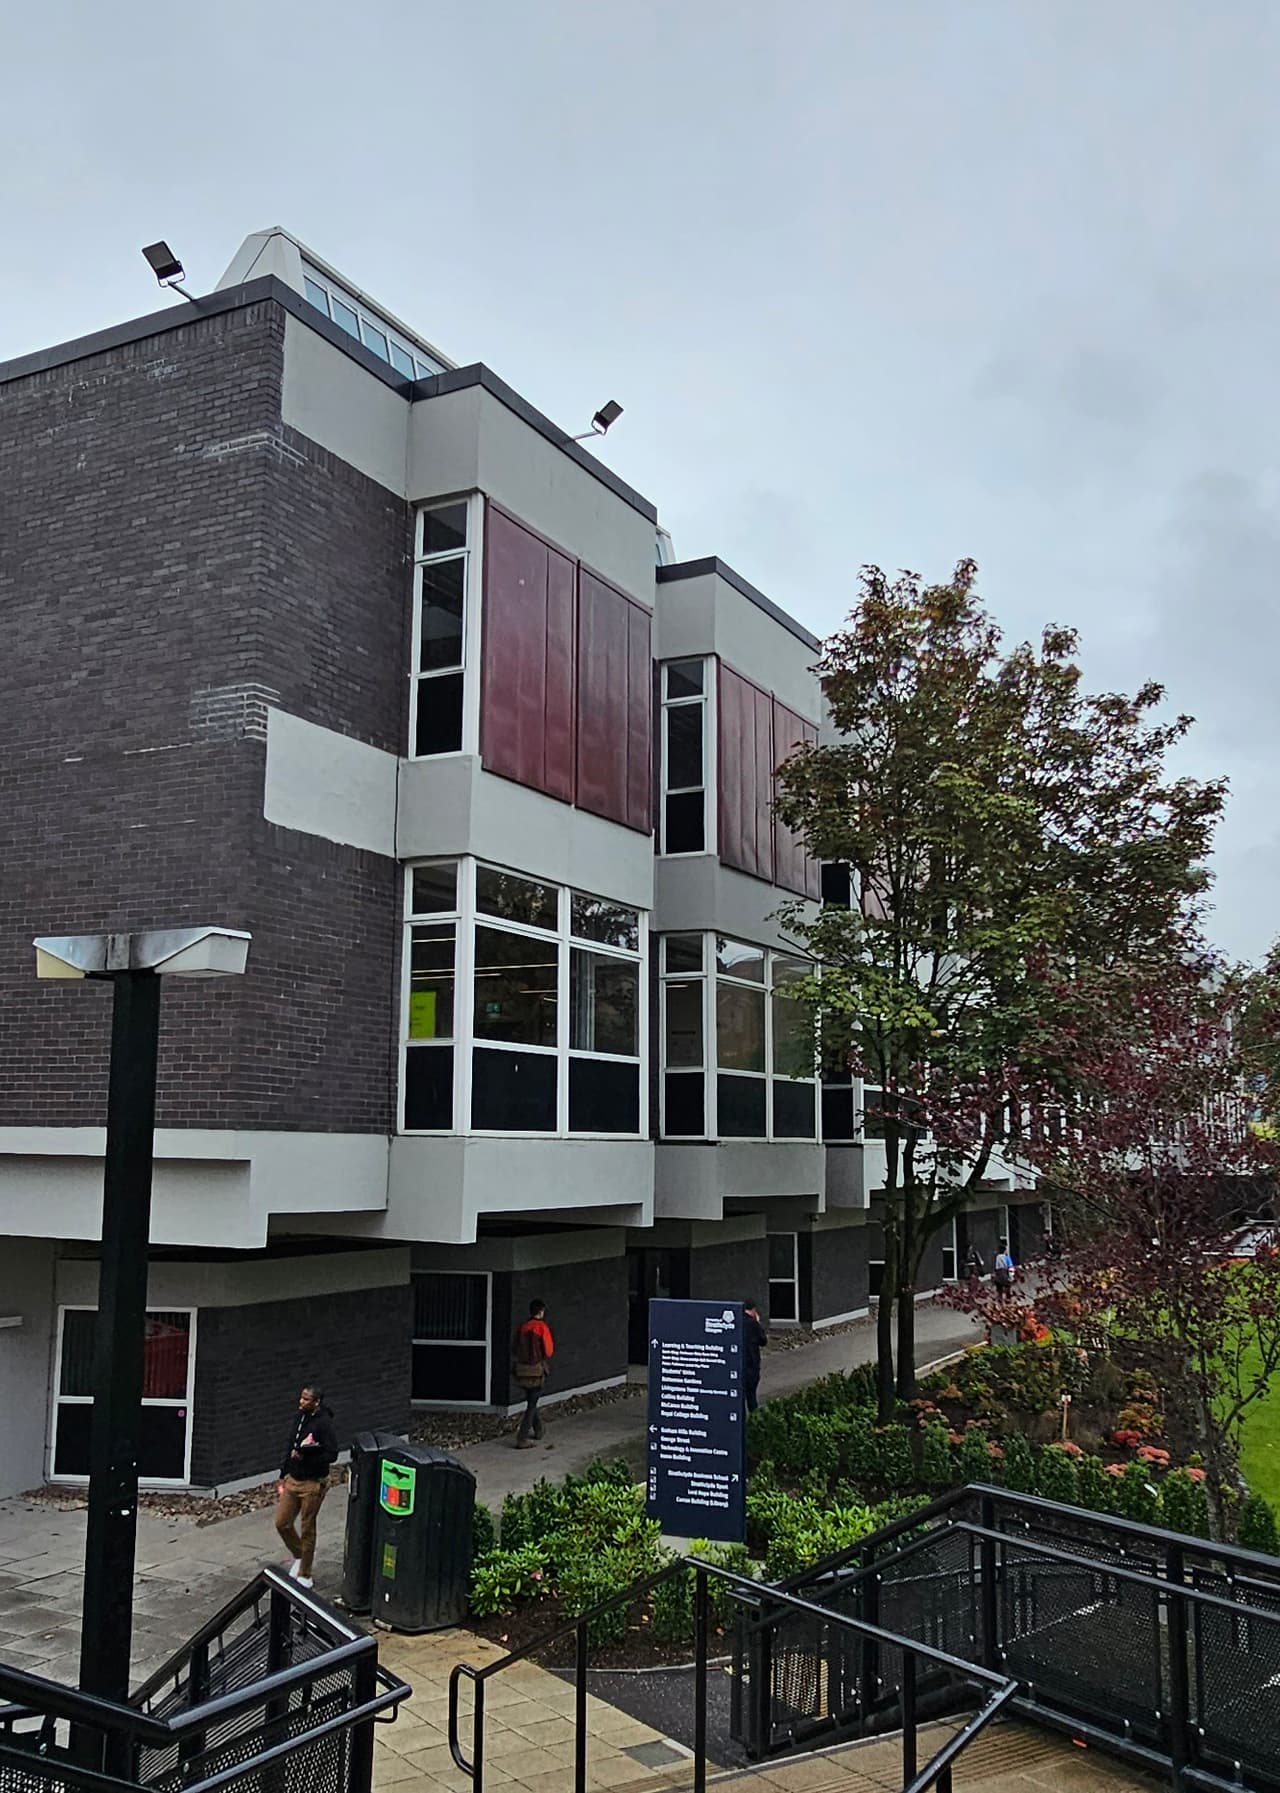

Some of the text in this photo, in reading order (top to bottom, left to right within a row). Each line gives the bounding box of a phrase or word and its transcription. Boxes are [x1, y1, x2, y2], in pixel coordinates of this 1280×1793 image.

[662, 1342, 680, 1350] Learning
[686, 1343, 704, 1351] Teaching
[676, 1394, 695, 1402] Building
[681, 1403, 699, 1411] Building
[690, 1412, 708, 1420] Building
[689, 1429, 707, 1438] Building
